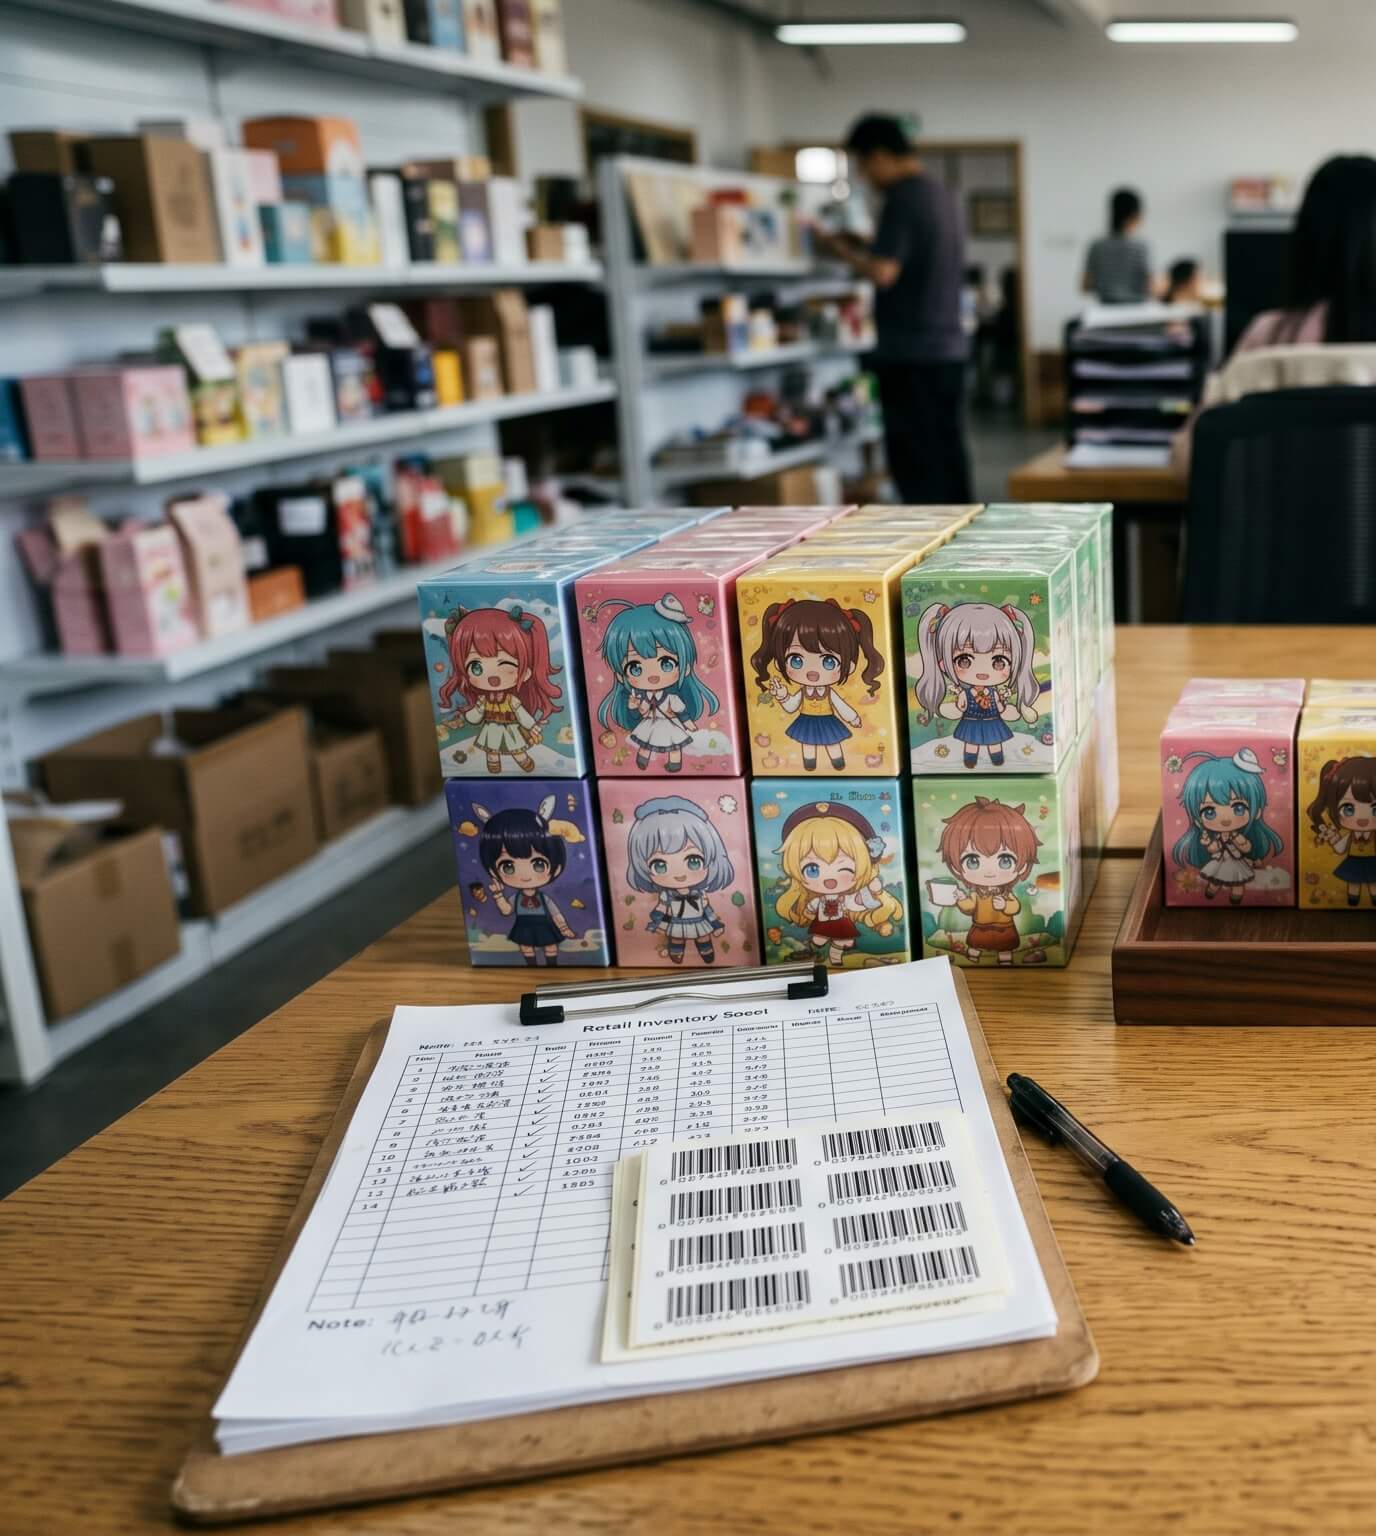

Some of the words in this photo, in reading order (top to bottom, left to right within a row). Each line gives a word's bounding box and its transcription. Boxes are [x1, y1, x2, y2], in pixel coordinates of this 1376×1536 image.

[582, 1020, 632, 1033] Retail
[638, 1013, 719, 1029] Inventory
[306, 1317, 375, 1331] Note:
